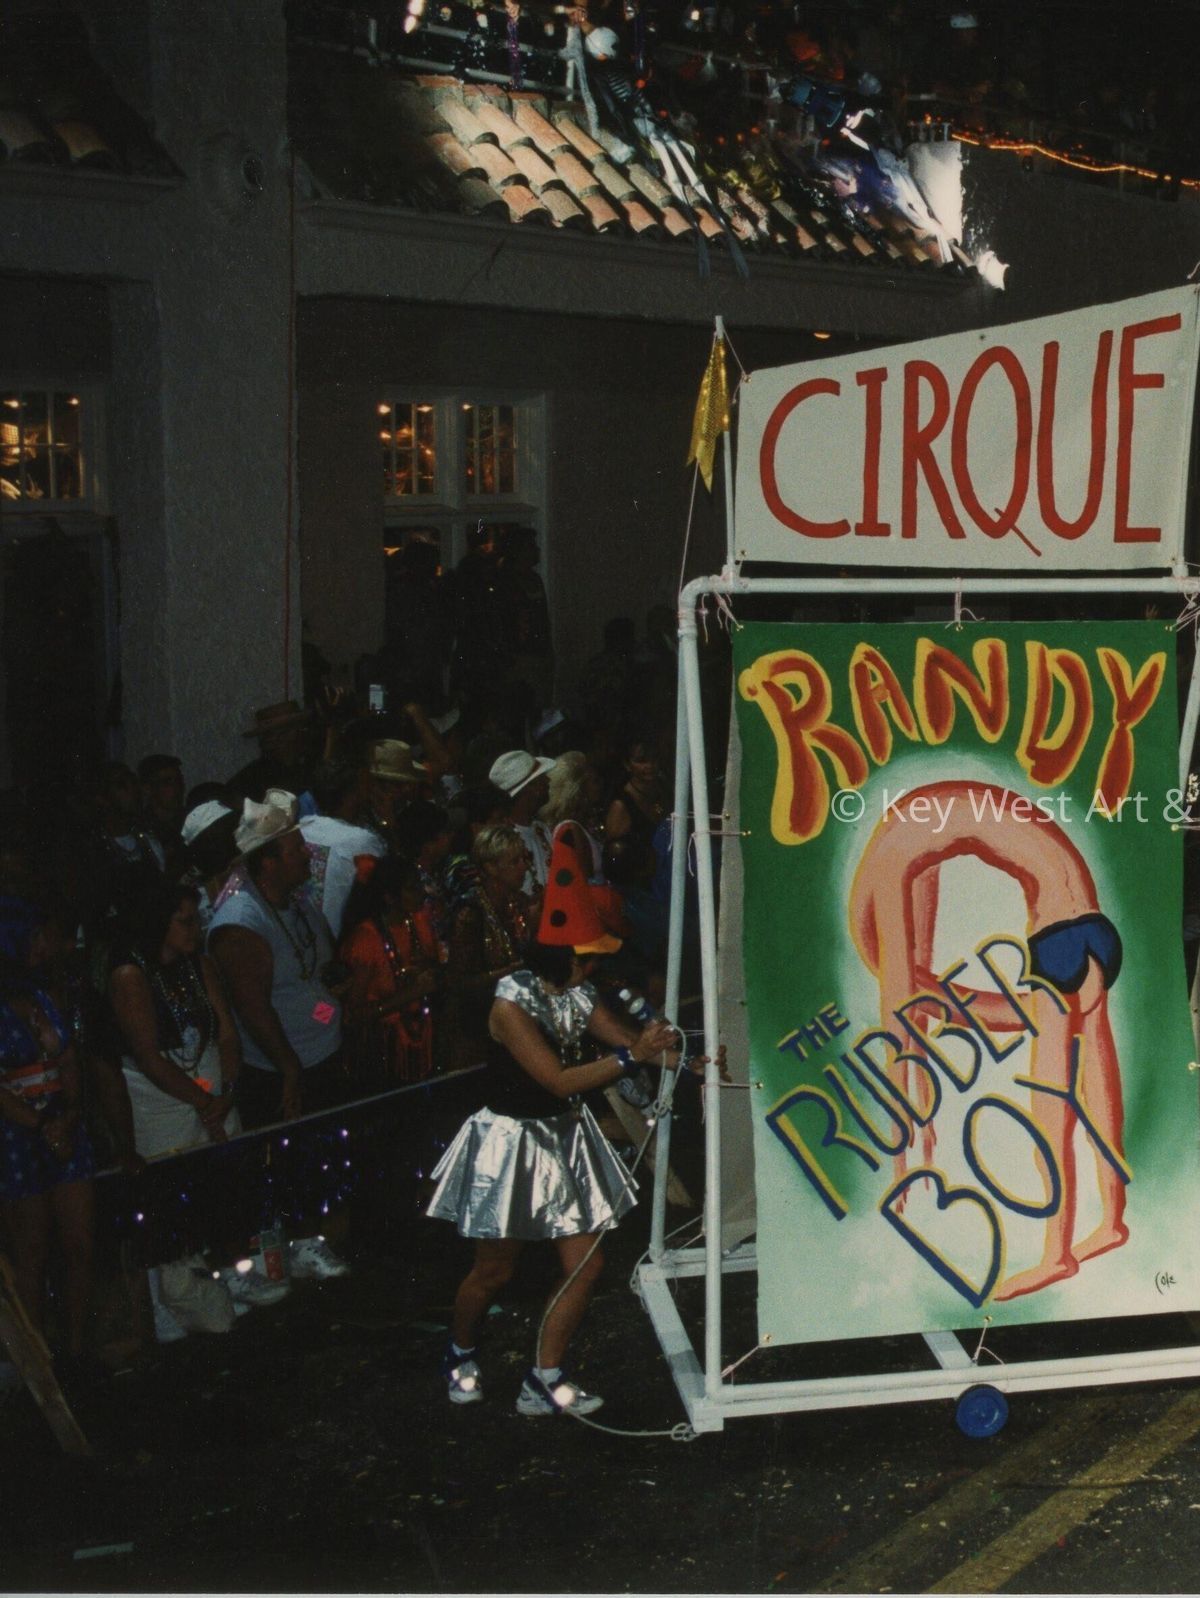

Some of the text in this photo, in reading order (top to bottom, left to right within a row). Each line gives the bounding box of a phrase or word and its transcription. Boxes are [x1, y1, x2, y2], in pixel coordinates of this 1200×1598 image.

[760, 313, 1181, 556] CIRQUE
[738, 637, 1166, 845] RANDY
[765, 933, 1071, 1221] RUBBER
[778, 1002, 849, 1062] THE
[879, 1034, 1133, 1308] BOY
